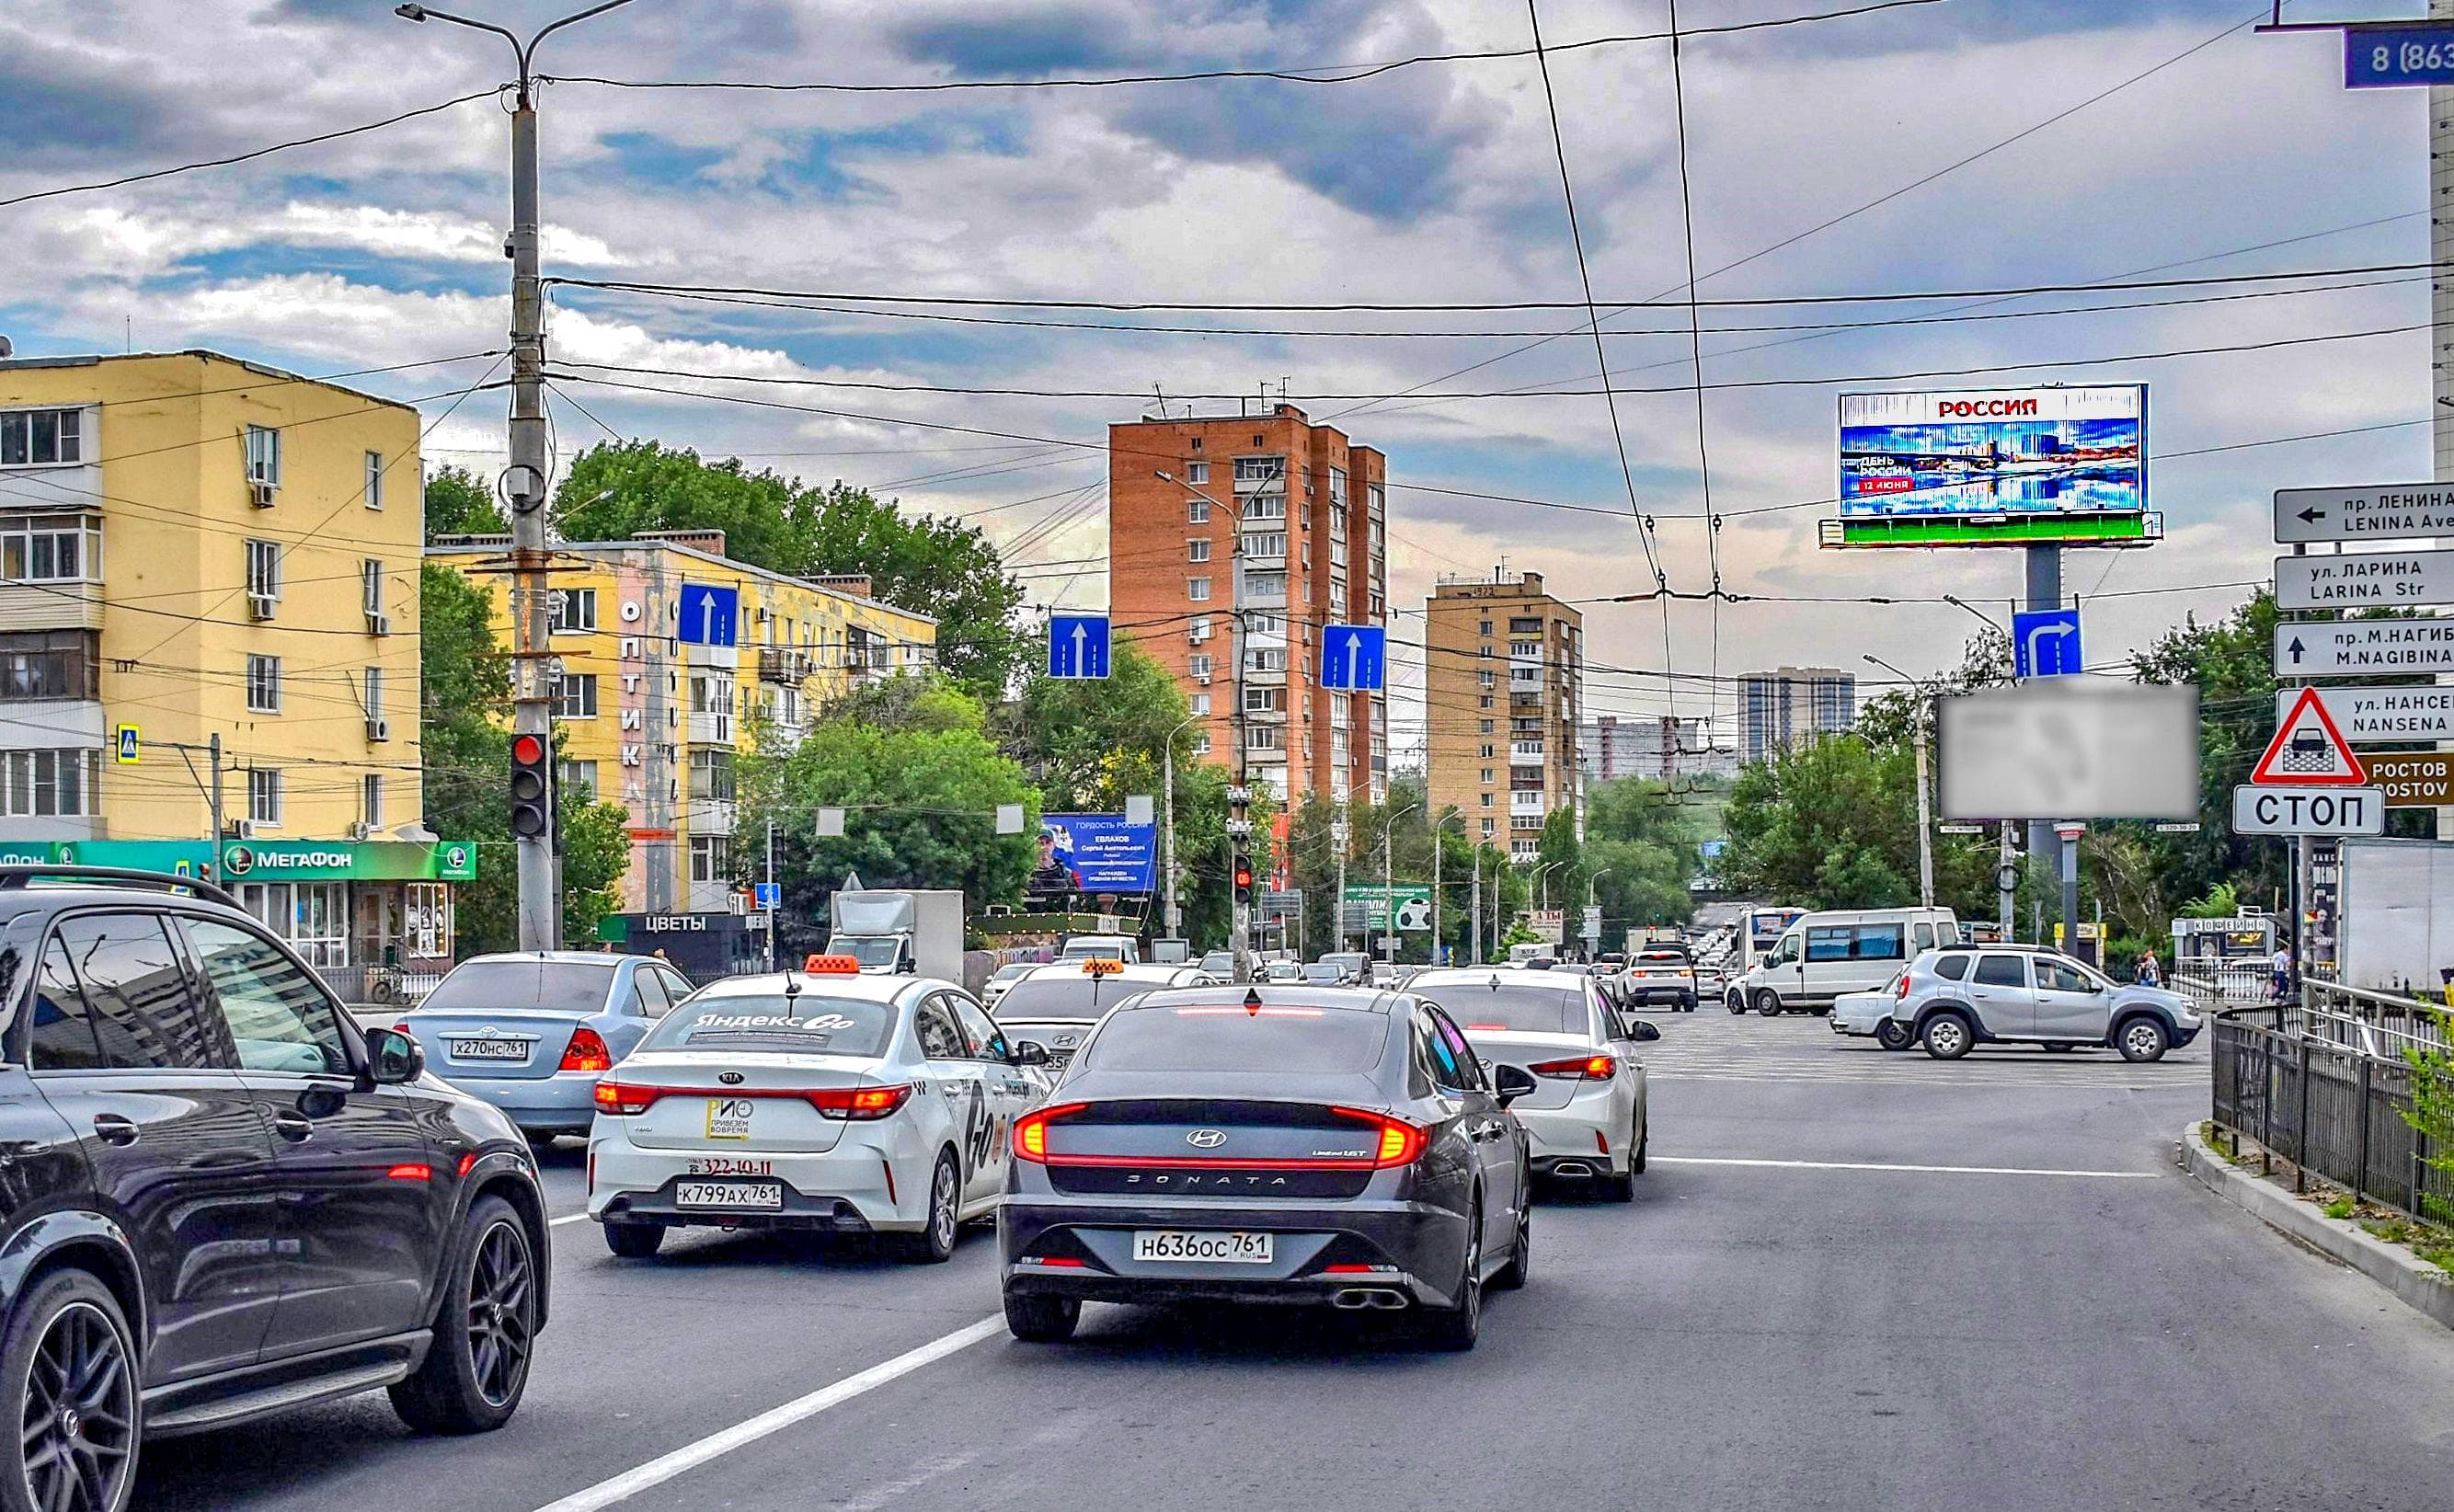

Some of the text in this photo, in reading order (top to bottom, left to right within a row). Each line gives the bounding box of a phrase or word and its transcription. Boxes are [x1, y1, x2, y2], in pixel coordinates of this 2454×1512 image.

[2372, 46, 2389, 72] 8
[1939, 399, 2037, 417] РОССИЯ
[1860, 456, 1895, 466] ДЕНЬ
[1860, 465, 1912, 476] РОССИИ
[2345, 493, 2454, 512] пр. ЛЕНИНА
[2345, 515, 2414, 531] LENINA
[2311, 561, 2422, 581] ул. ЛАРИНА
[2311, 582, 2425, 599] LARINA Str
[2335, 634, 2362, 647] пр.
[2337, 649, 2451, 664] M.NAGIBINA
[621, 601, 641, 802] ОПТИКА
[2355, 695, 2454, 713] ул. НАНСЕ
[2354, 717, 2447, 731] NANSENA
[2373, 762, 2447, 777] РОСТОВ
[2256, 795, 2363, 826] СТОП
[646, 916, 706, 933] ЦВЕТЫ
[2194, 921, 2265, 931] КОФЕЙНЯ
[693, 1014, 854, 1029] Яндекс Go
[456, 1041, 523, 1055] Х270НС 761
[722, 1073, 740, 1082] KIA
[711, 1119, 749, 1128] ПРИВЕЗЕМ
[704, 1159, 771, 1175] 322-10-11
[1127, 1174, 1286, 1185] SONATA
[682, 1186, 776, 1203] К799АХ 761
[1142, 1234, 1266, 1257] Н636ОС 761
